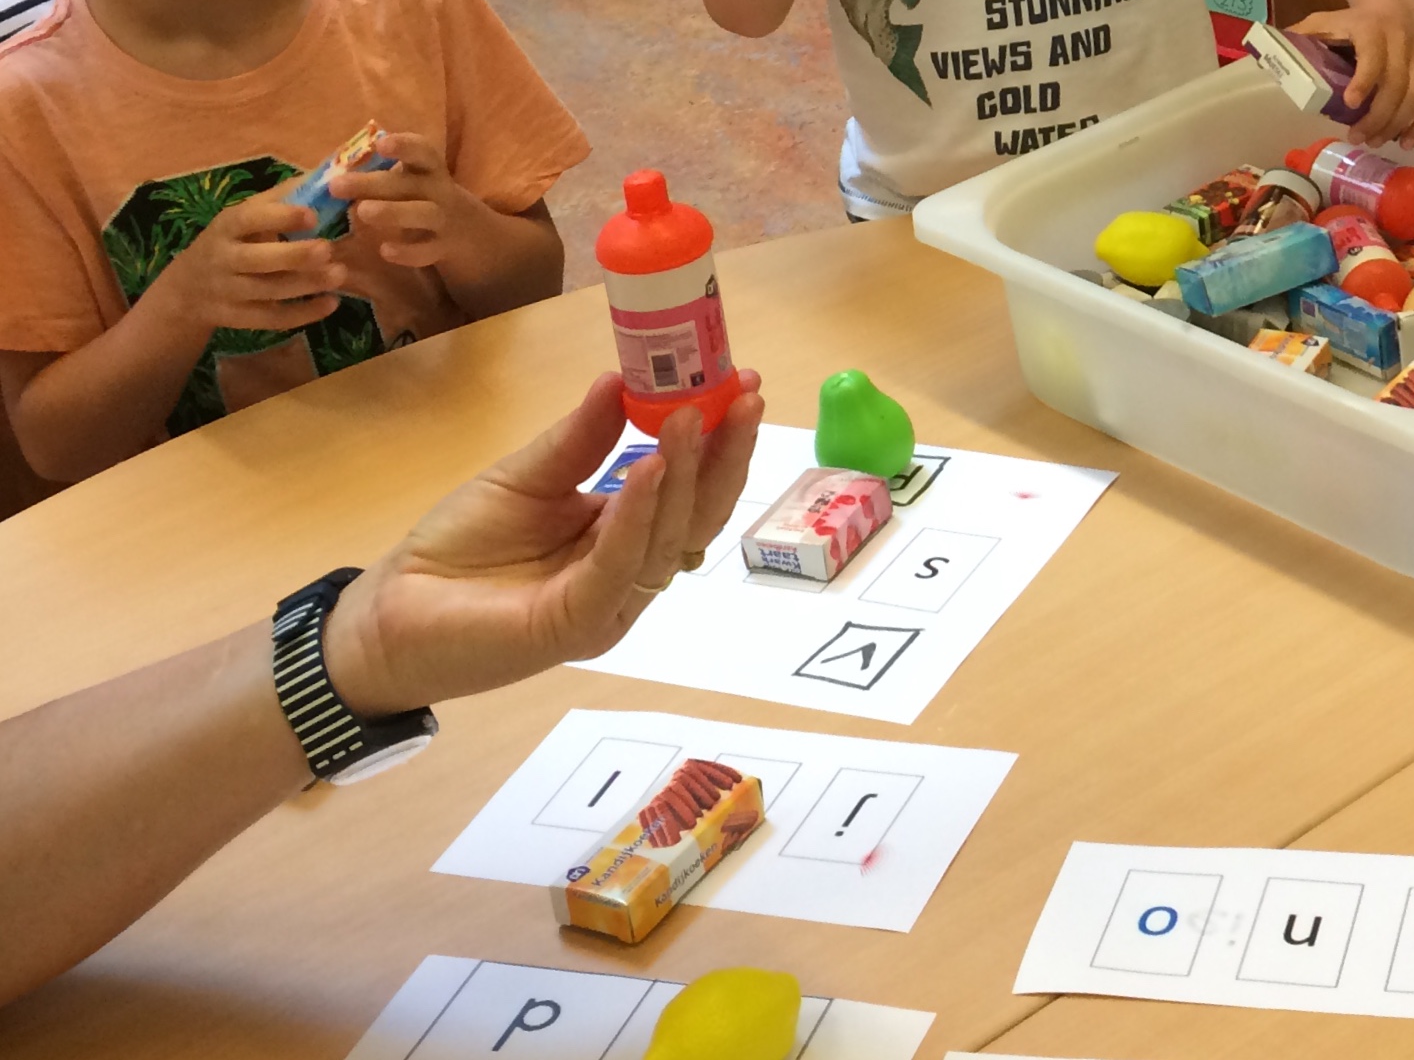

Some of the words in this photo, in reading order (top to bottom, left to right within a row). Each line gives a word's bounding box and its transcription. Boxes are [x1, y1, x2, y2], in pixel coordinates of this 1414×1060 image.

[930, 44, 1033, 81] VIEWS
[1048, 24, 1112, 67] AND
[977, 81, 1061, 120] COLD
[758, 547, 800, 561] taart
[914, 556, 950, 579] s
[654, 842, 718, 908] Kandijkoeken
[1137, 906, 1178, 936] o
